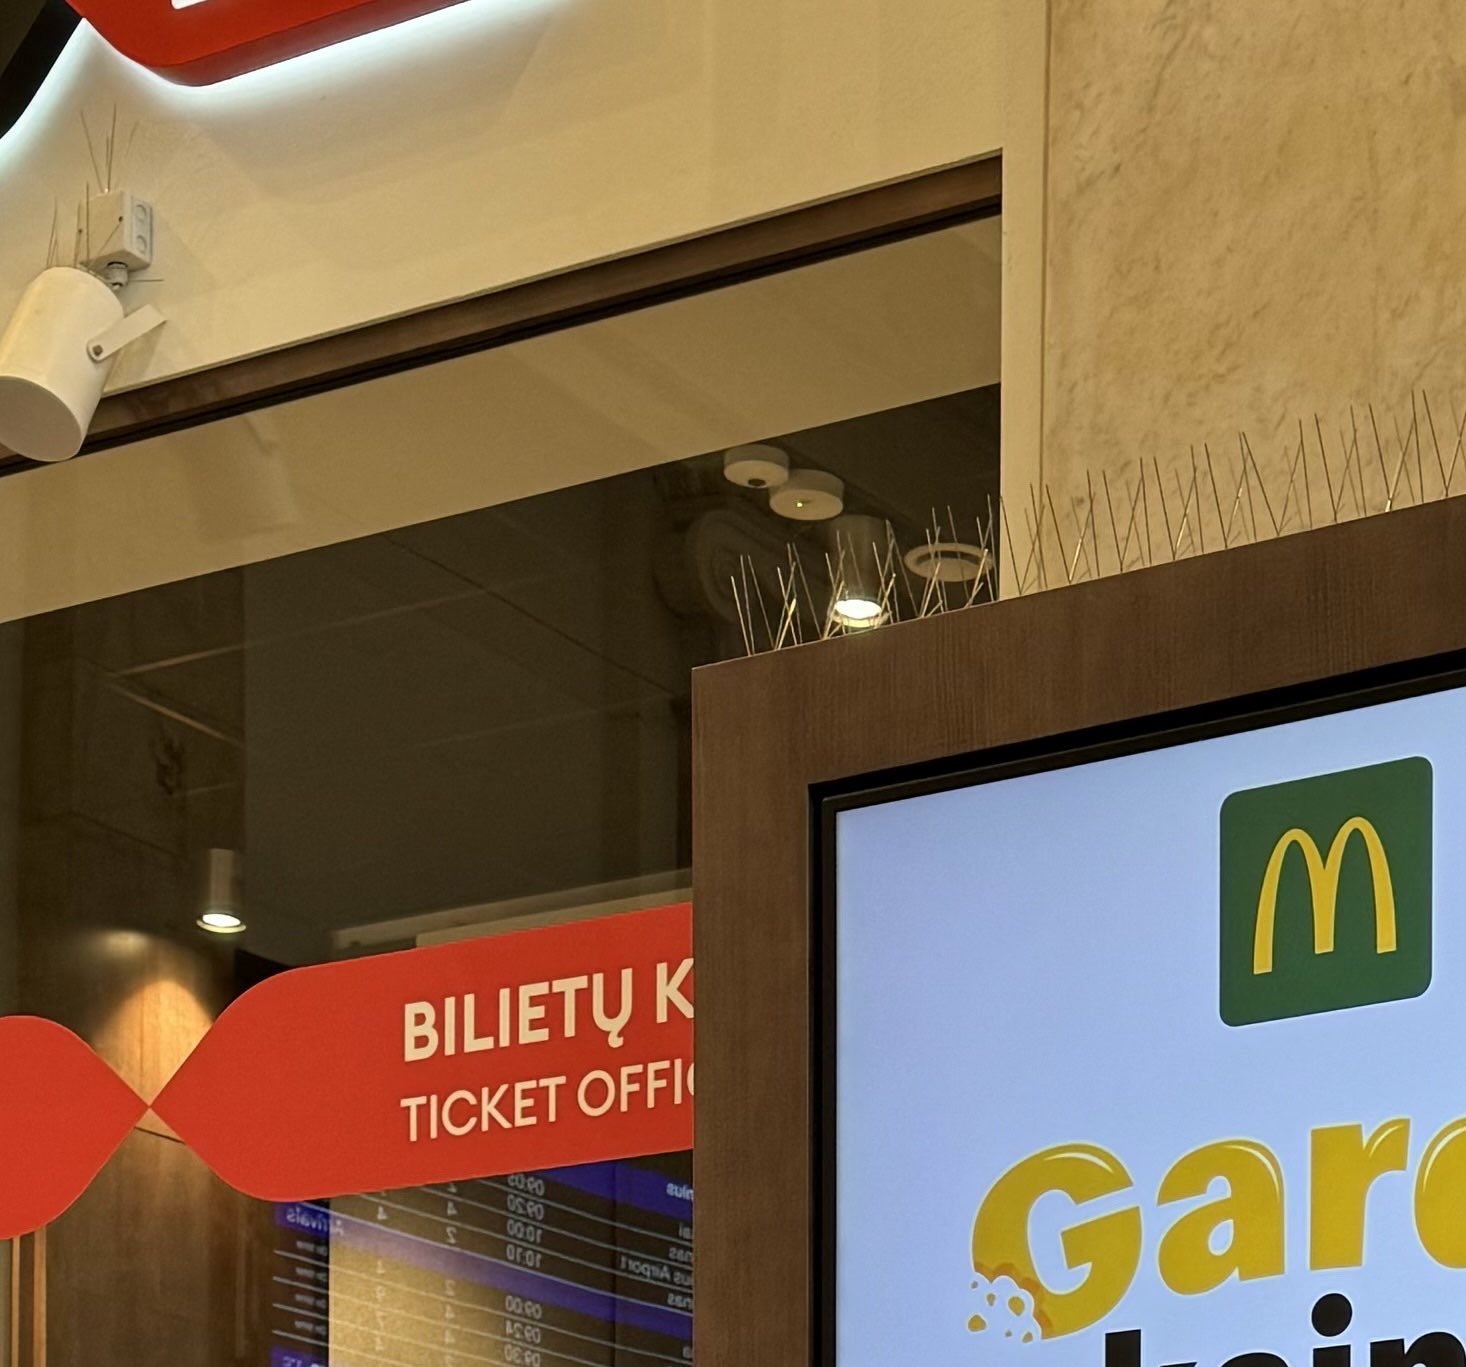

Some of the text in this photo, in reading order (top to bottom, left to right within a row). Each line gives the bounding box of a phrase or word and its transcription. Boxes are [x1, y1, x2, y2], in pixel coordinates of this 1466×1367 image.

[402, 968, 633, 1063] BILIETŲ
[400, 1057, 694, 1143] TICKET OFFI
